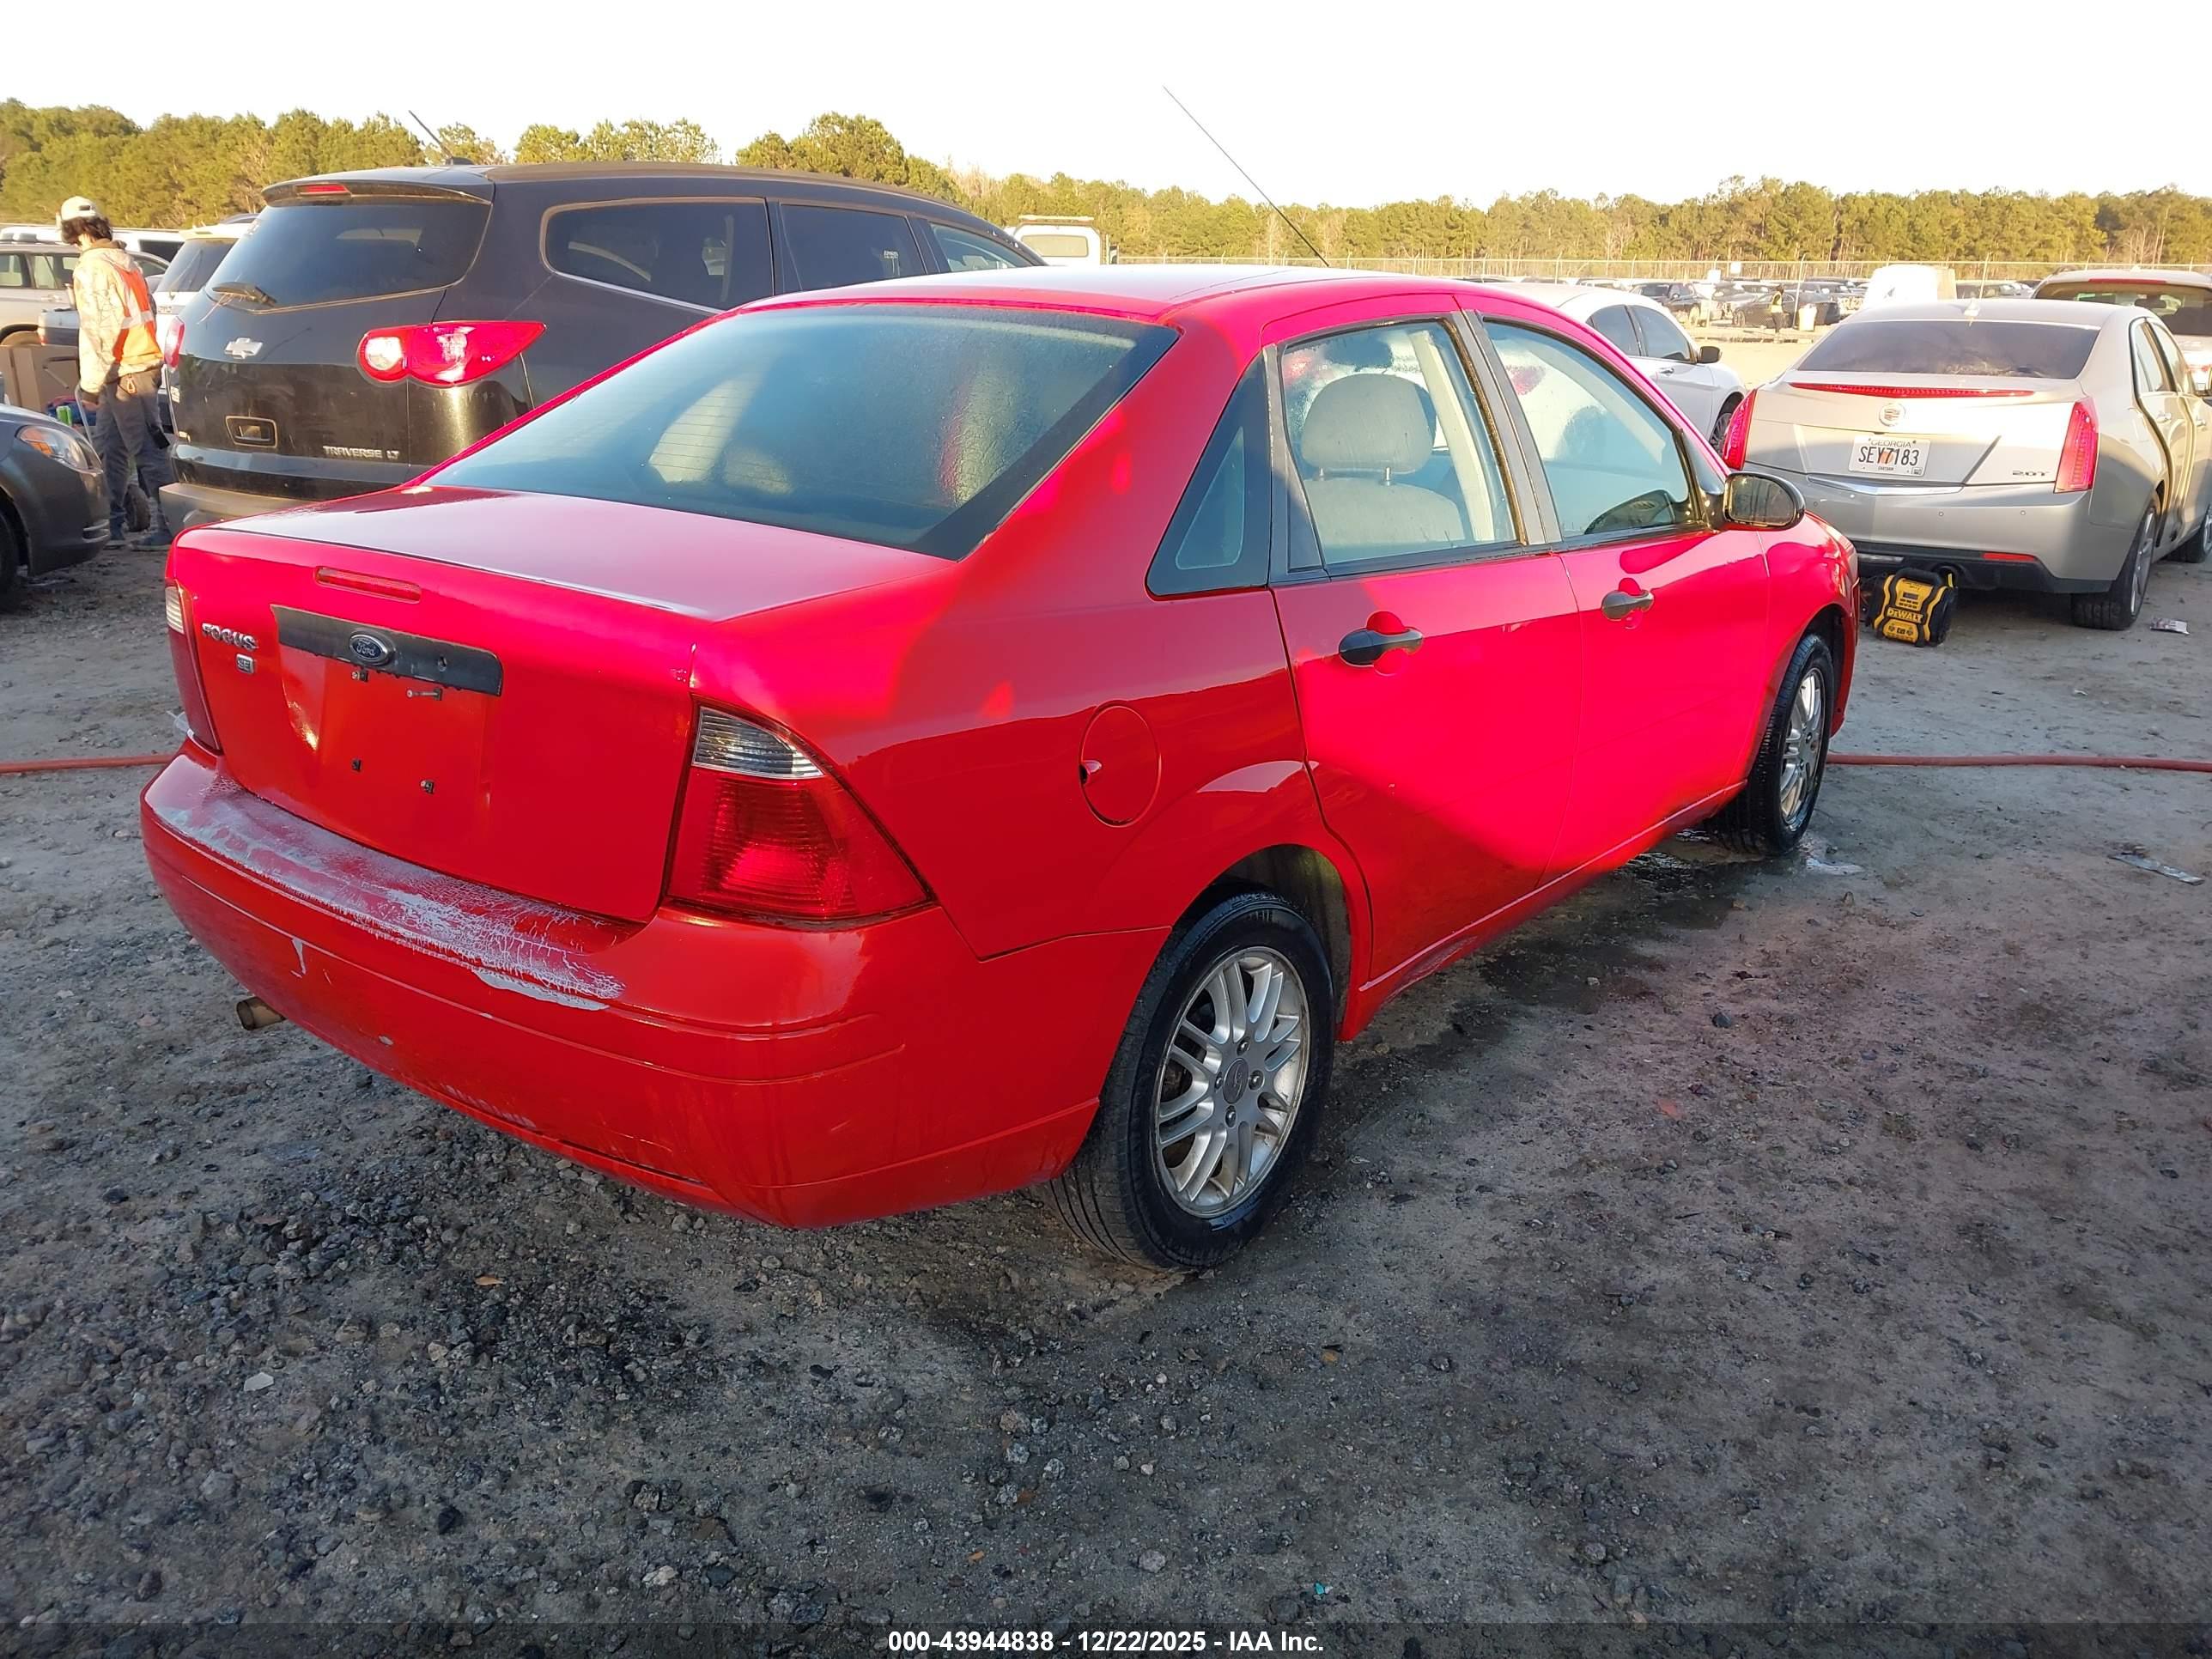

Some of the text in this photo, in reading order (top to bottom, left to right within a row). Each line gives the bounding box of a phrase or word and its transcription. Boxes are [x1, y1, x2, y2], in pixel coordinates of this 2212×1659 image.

[1870, 439, 1911, 448] GEORGIA
[322, 446, 399, 459] TRAVERSE LT
[1858, 446, 1920, 466] SEY7183
[201, 623, 258, 651] FOCUS
